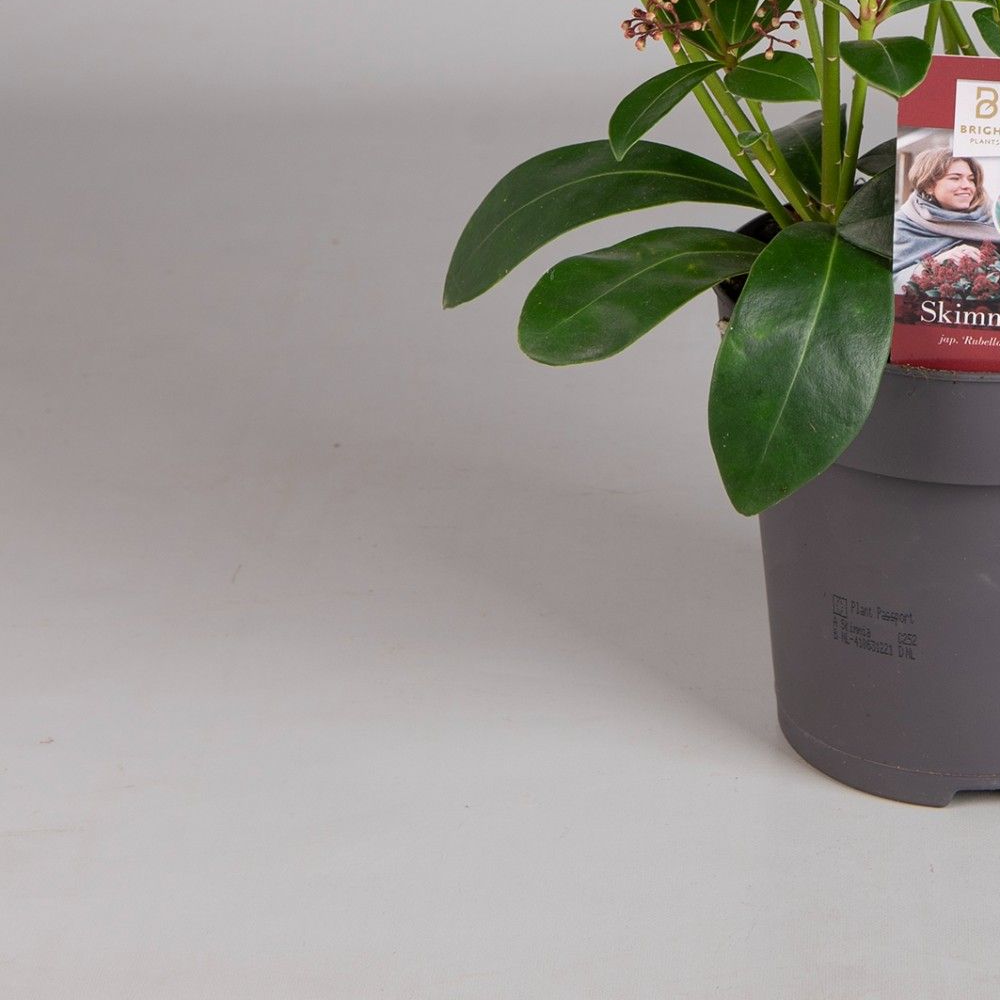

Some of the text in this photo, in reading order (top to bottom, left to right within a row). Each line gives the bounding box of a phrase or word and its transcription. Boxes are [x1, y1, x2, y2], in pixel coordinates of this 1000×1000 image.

[969, 137, 1000, 146] PLANTS
[937, 334, 959, 346] jap.
[850, 600, 915, 626] Plant Passport
